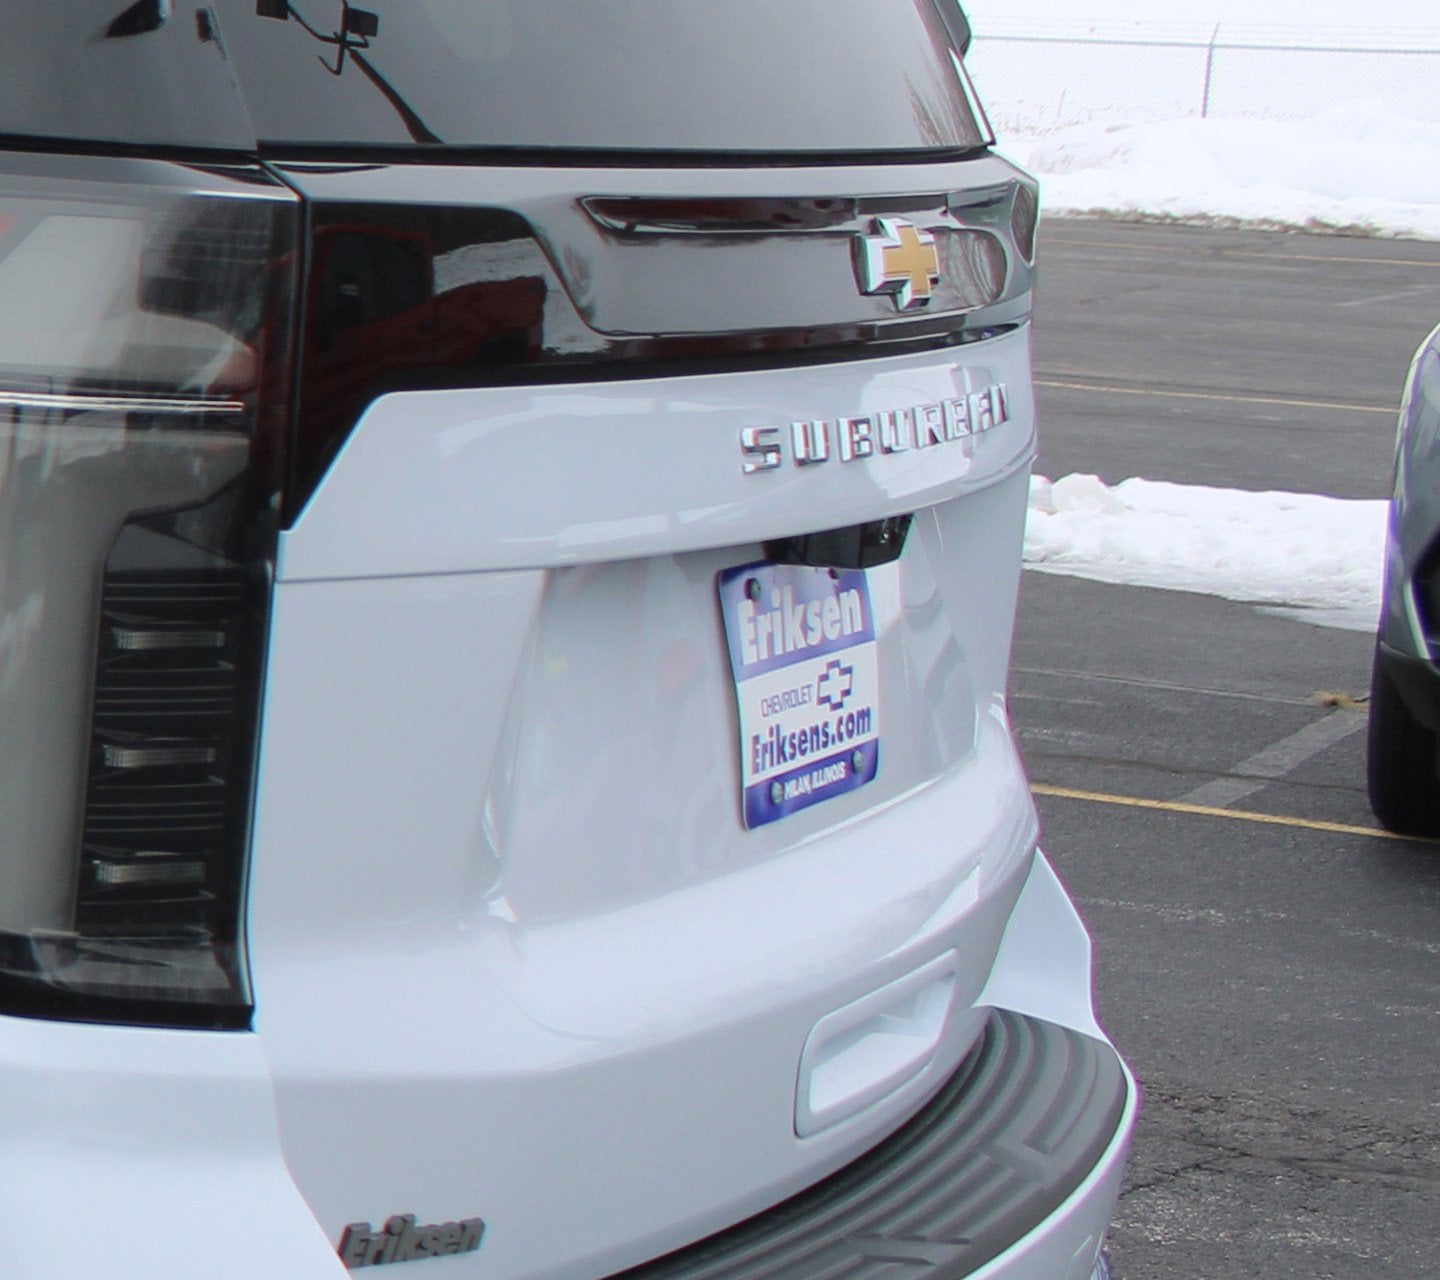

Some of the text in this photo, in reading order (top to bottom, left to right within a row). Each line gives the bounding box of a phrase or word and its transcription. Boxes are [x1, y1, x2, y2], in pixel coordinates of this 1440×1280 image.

[739, 383, 1010, 475] SUBURBAN
[737, 584, 863, 666] Eriksen
[761, 683, 813, 718] CHEVROLET
[751, 705, 872, 776] Eriksens.com
[812, 760, 846, 793] ILLINOIS
[337, 1212, 486, 1270] Eriksen
